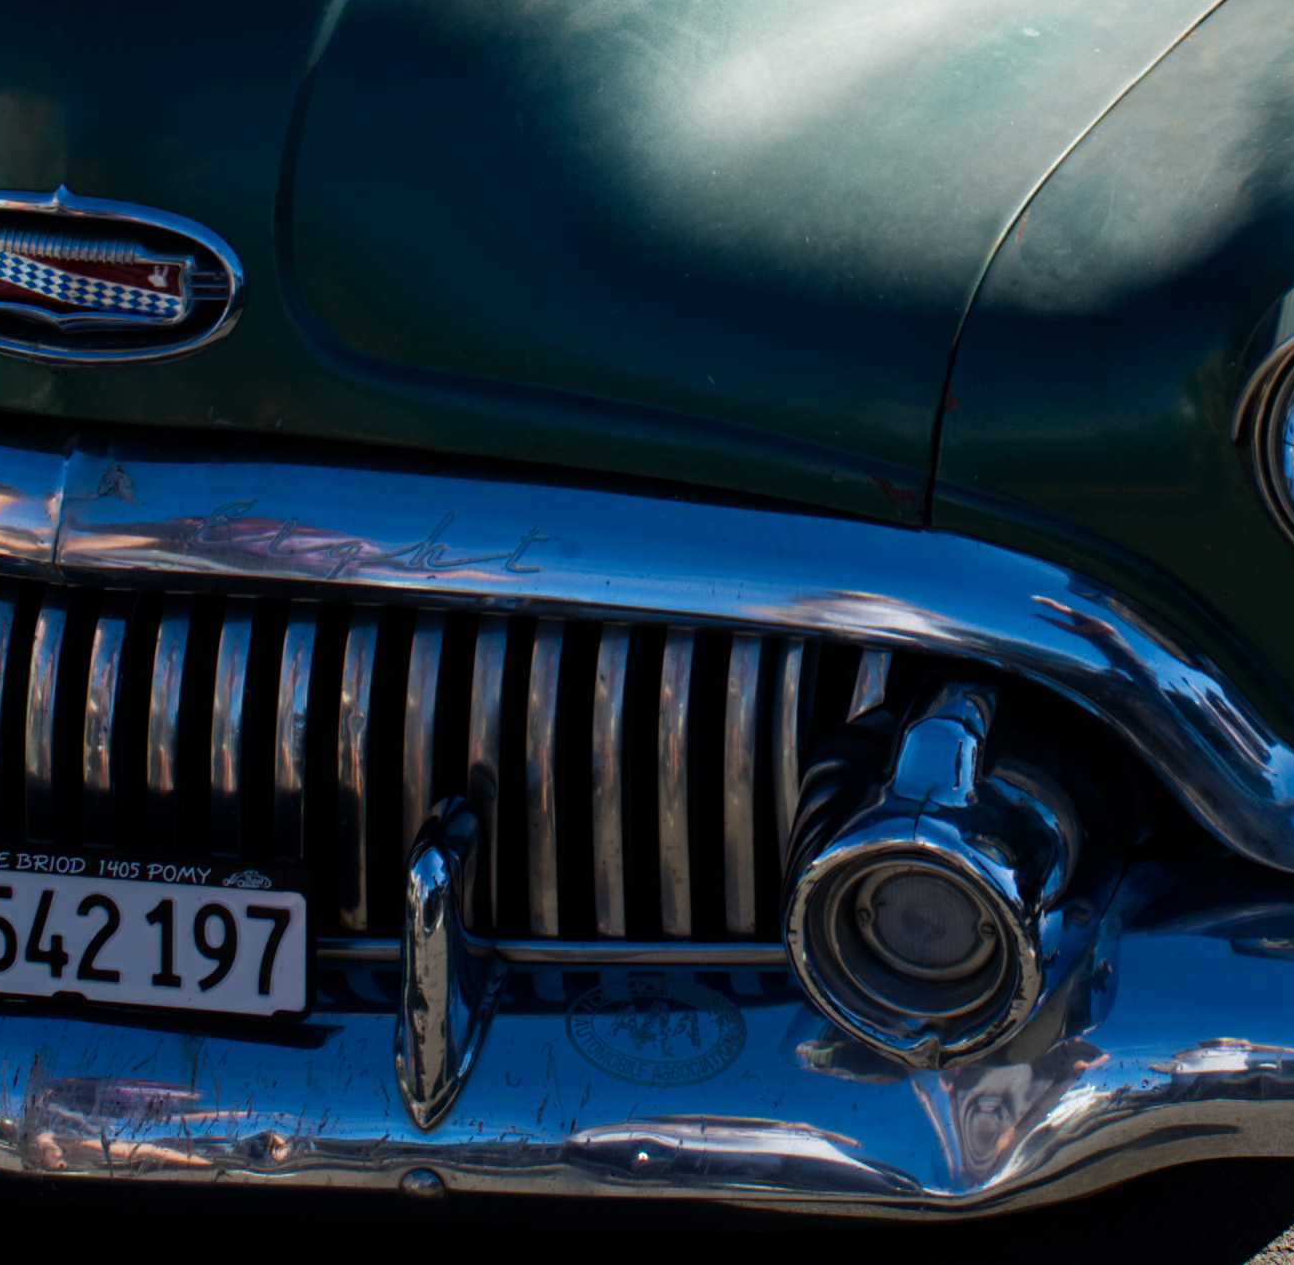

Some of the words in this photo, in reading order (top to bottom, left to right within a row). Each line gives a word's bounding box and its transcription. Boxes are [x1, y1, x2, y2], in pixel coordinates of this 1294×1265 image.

[16, 852, 86, 875] BRIOD
[99, 858, 140, 879] 1405
[147, 863, 212, 885] POMY
[573, 1017, 650, 1079] AUTOMOBILE
